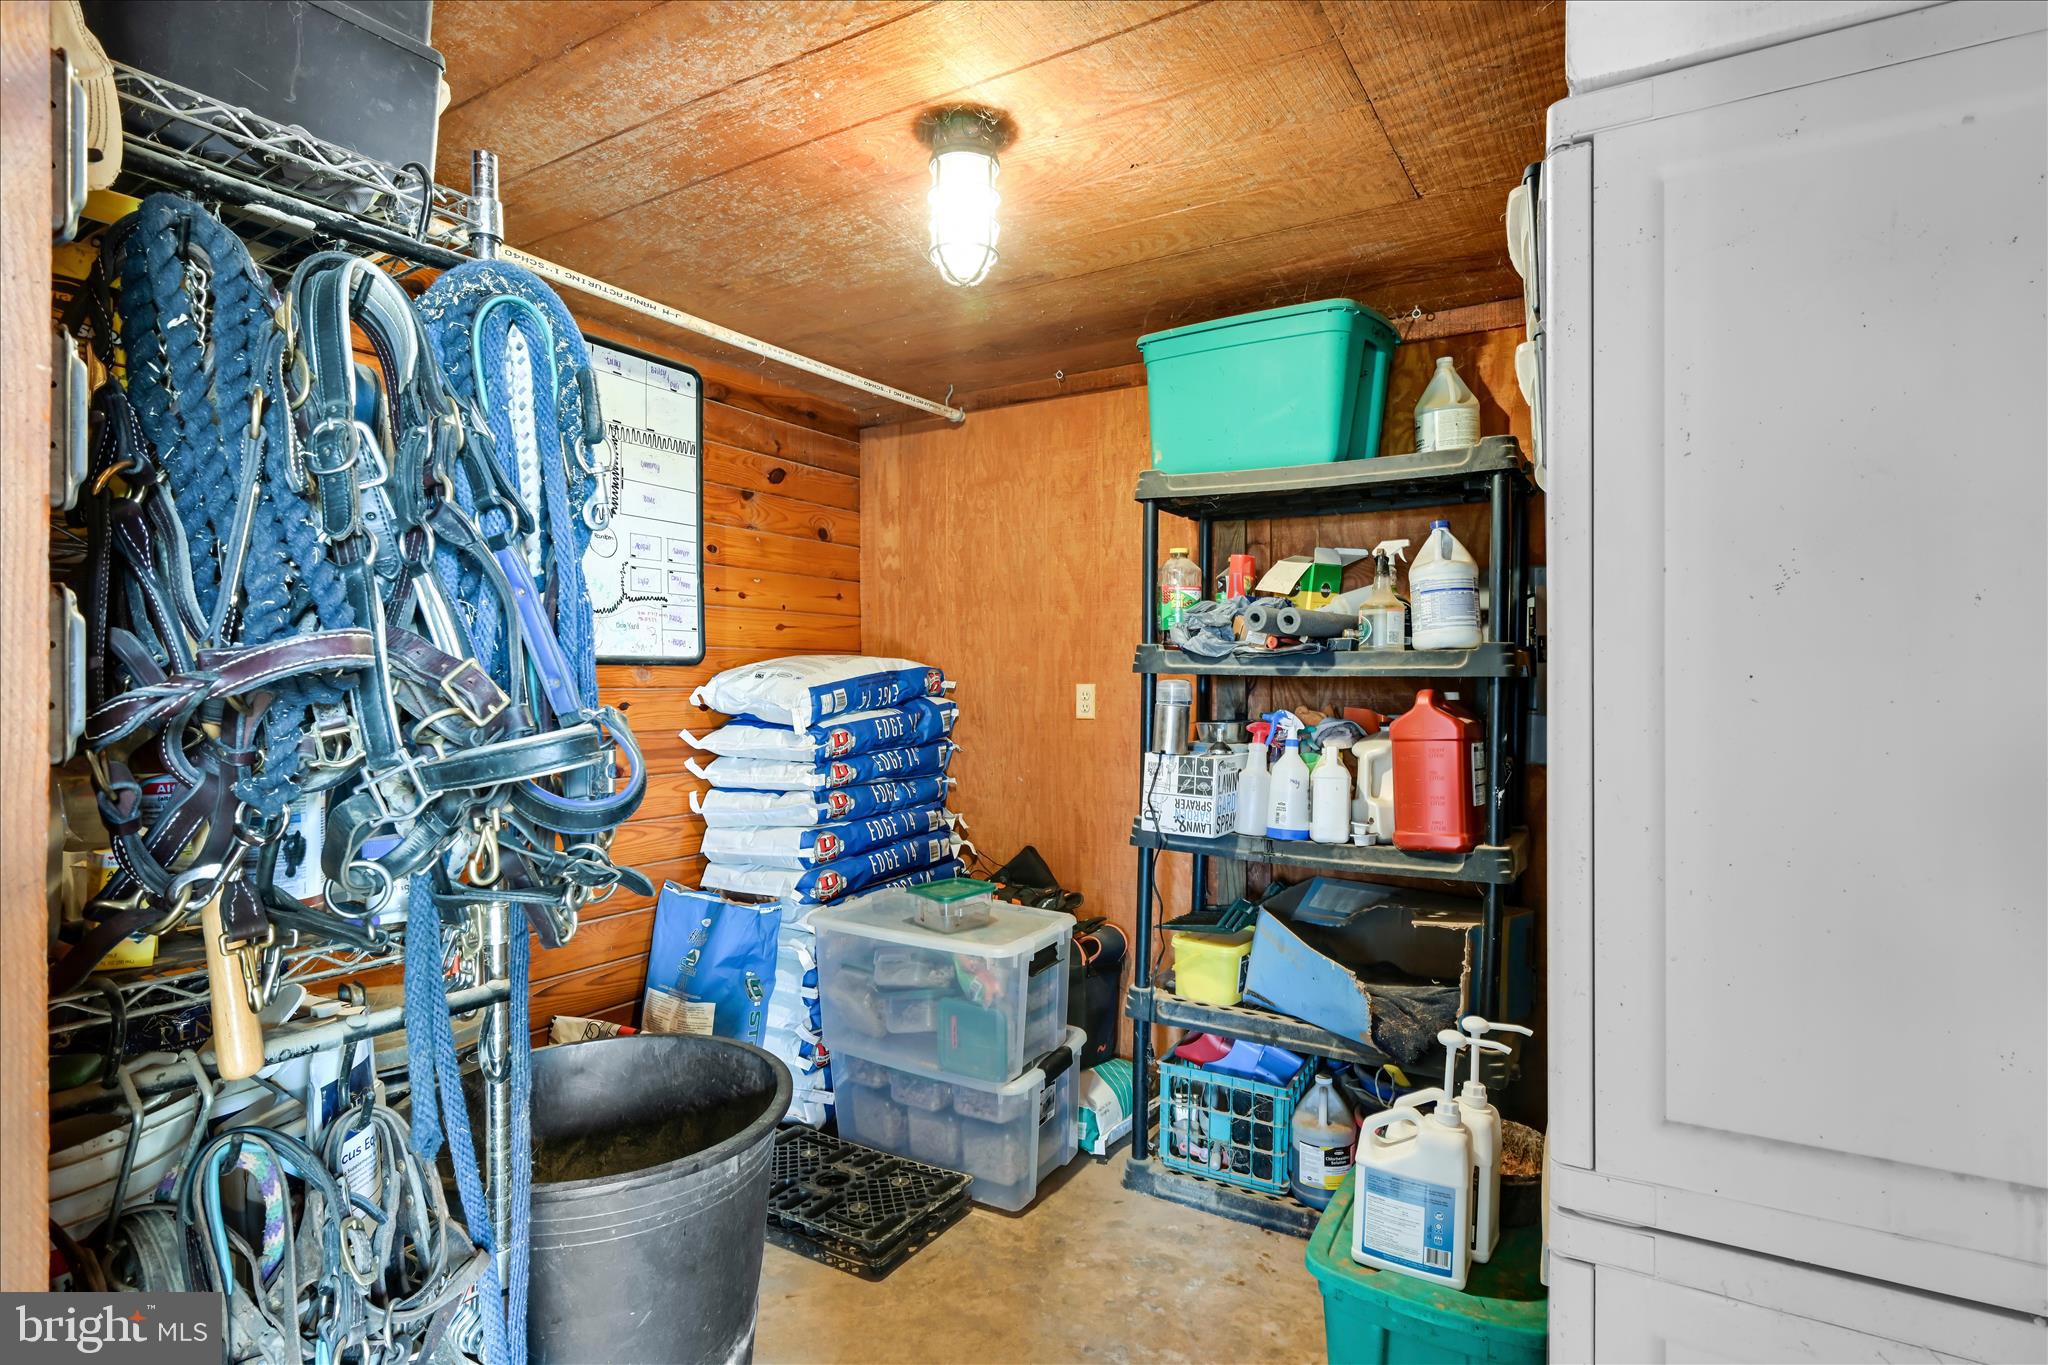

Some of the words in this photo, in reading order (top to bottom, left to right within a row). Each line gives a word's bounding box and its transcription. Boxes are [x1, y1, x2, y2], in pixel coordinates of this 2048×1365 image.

[563, 271, 657, 311] MANUFACTURING
[874, 716, 904, 740] EDGE
[871, 749, 903, 772] EDGE
[905, 747, 920, 767] 14
[871, 782, 900, 803] EDGE
[1174, 798, 1212, 812] SPRAYER
[1174, 809, 1212, 822] GARDEN
[865, 815, 898, 841] EDGE
[901, 812, 916, 832] 14
[1186, 821, 1212, 835] LAWN
[868, 848, 900, 875] EDGE
[903, 842, 917, 864] 14
